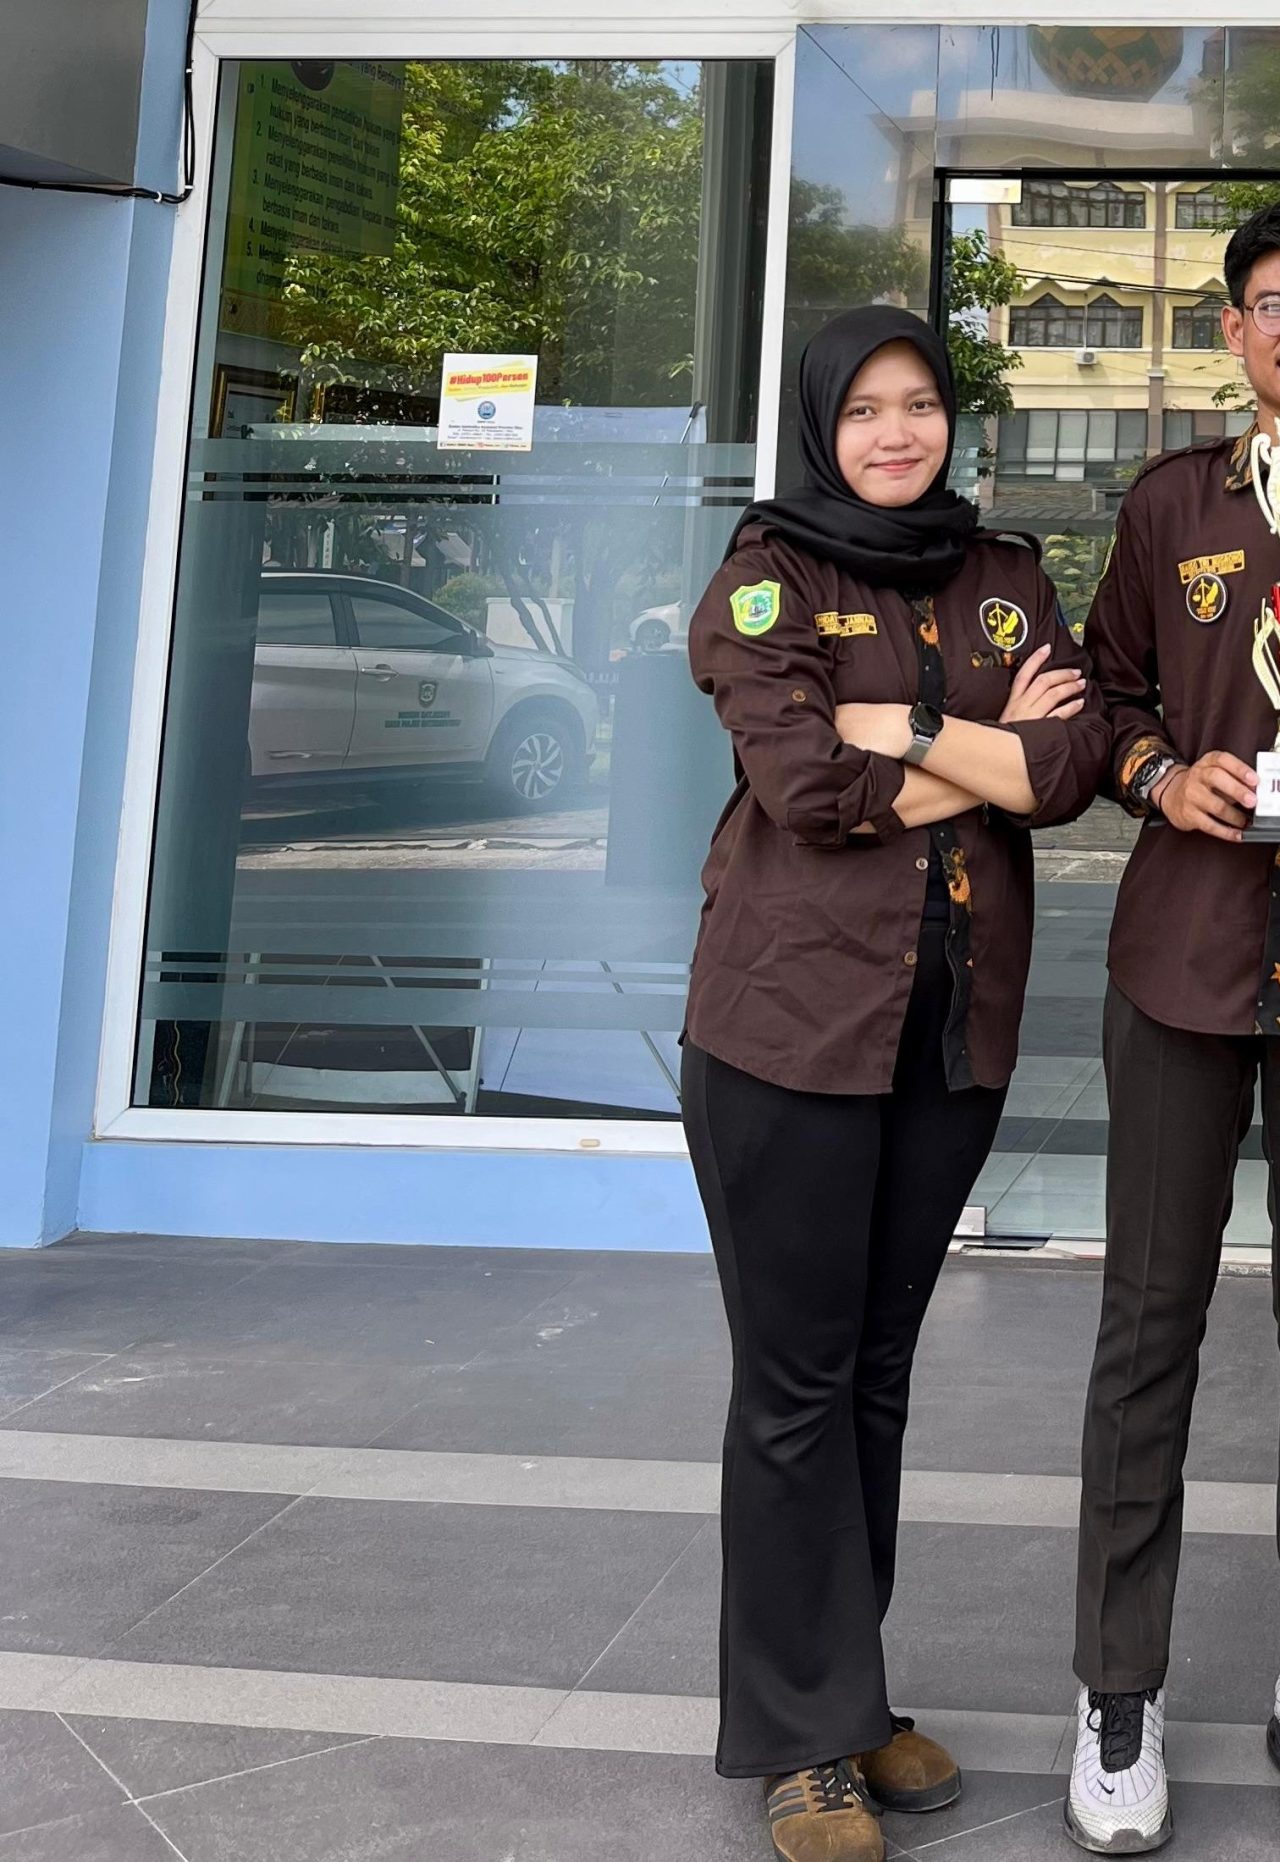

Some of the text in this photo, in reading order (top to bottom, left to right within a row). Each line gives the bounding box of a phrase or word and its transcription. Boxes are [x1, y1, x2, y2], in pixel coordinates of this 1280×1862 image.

[270, 101, 293, 123] hukum
[293, 115, 310, 134] yang
[268, 124, 328, 159] Menyelenggarakan
[264, 172, 324, 206] Menyelenggarakan
[284, 158, 301, 178] yang
[301, 160, 328, 184] berbasis
[344, 176, 356, 193] dan
[263, 195, 291, 218] berbasis
[308, 211, 321, 227] dan
